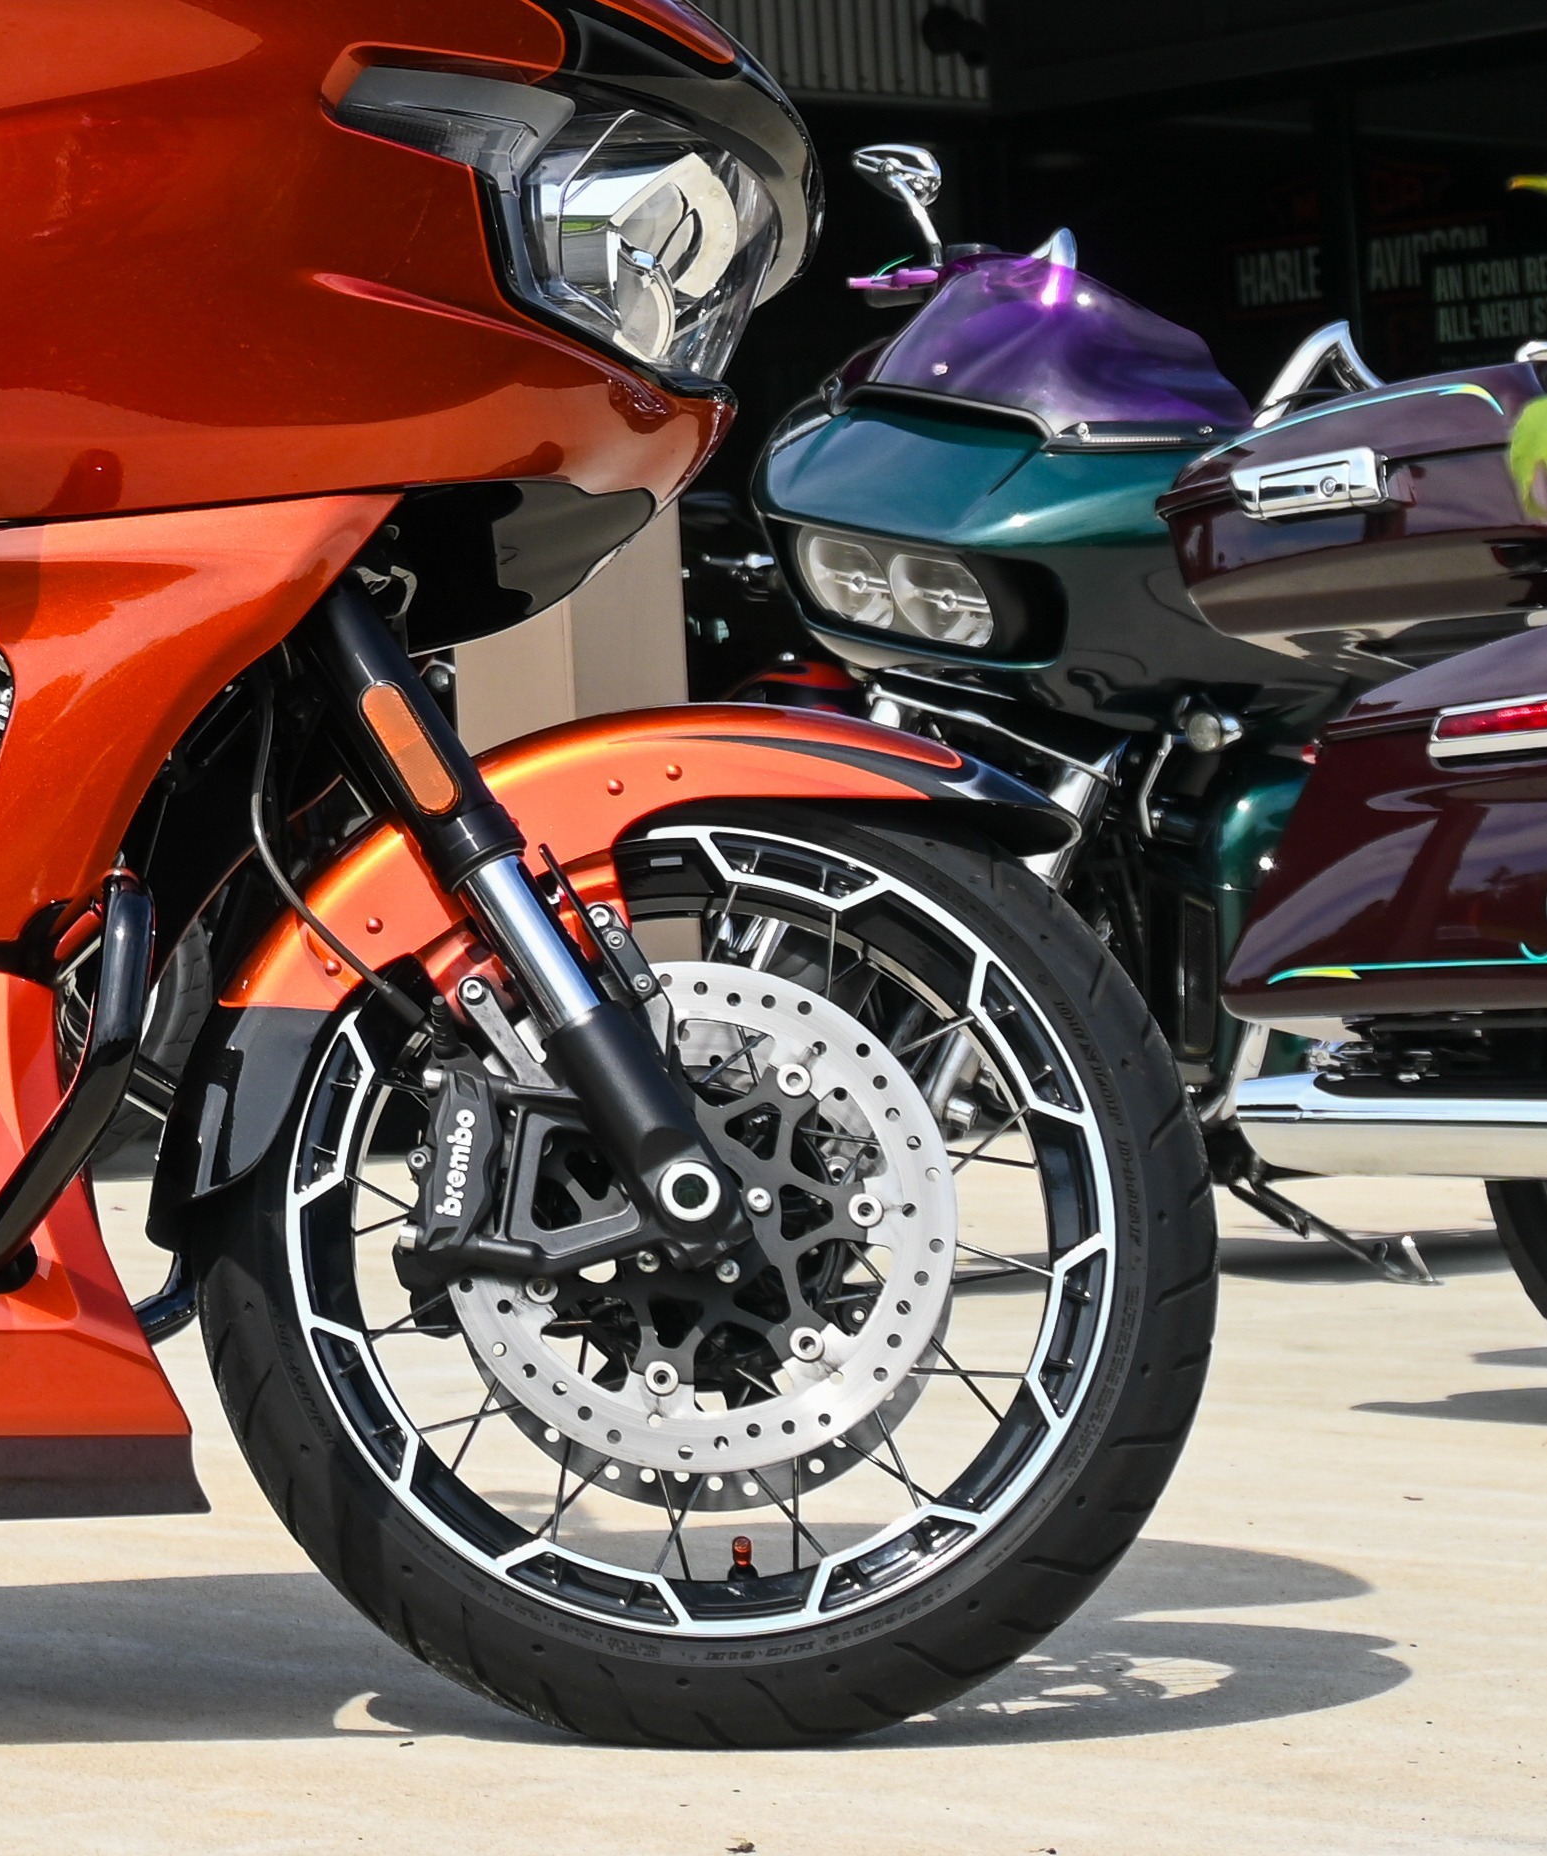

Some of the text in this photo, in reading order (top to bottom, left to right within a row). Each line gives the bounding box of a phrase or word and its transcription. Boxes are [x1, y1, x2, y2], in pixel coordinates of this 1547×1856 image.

[1434, 264, 1465, 303] AN
[1465, 256, 1522, 299] ICON
[1439, 300, 1529, 343] ALL-NEW
[434, 1108, 476, 1217] brembo
